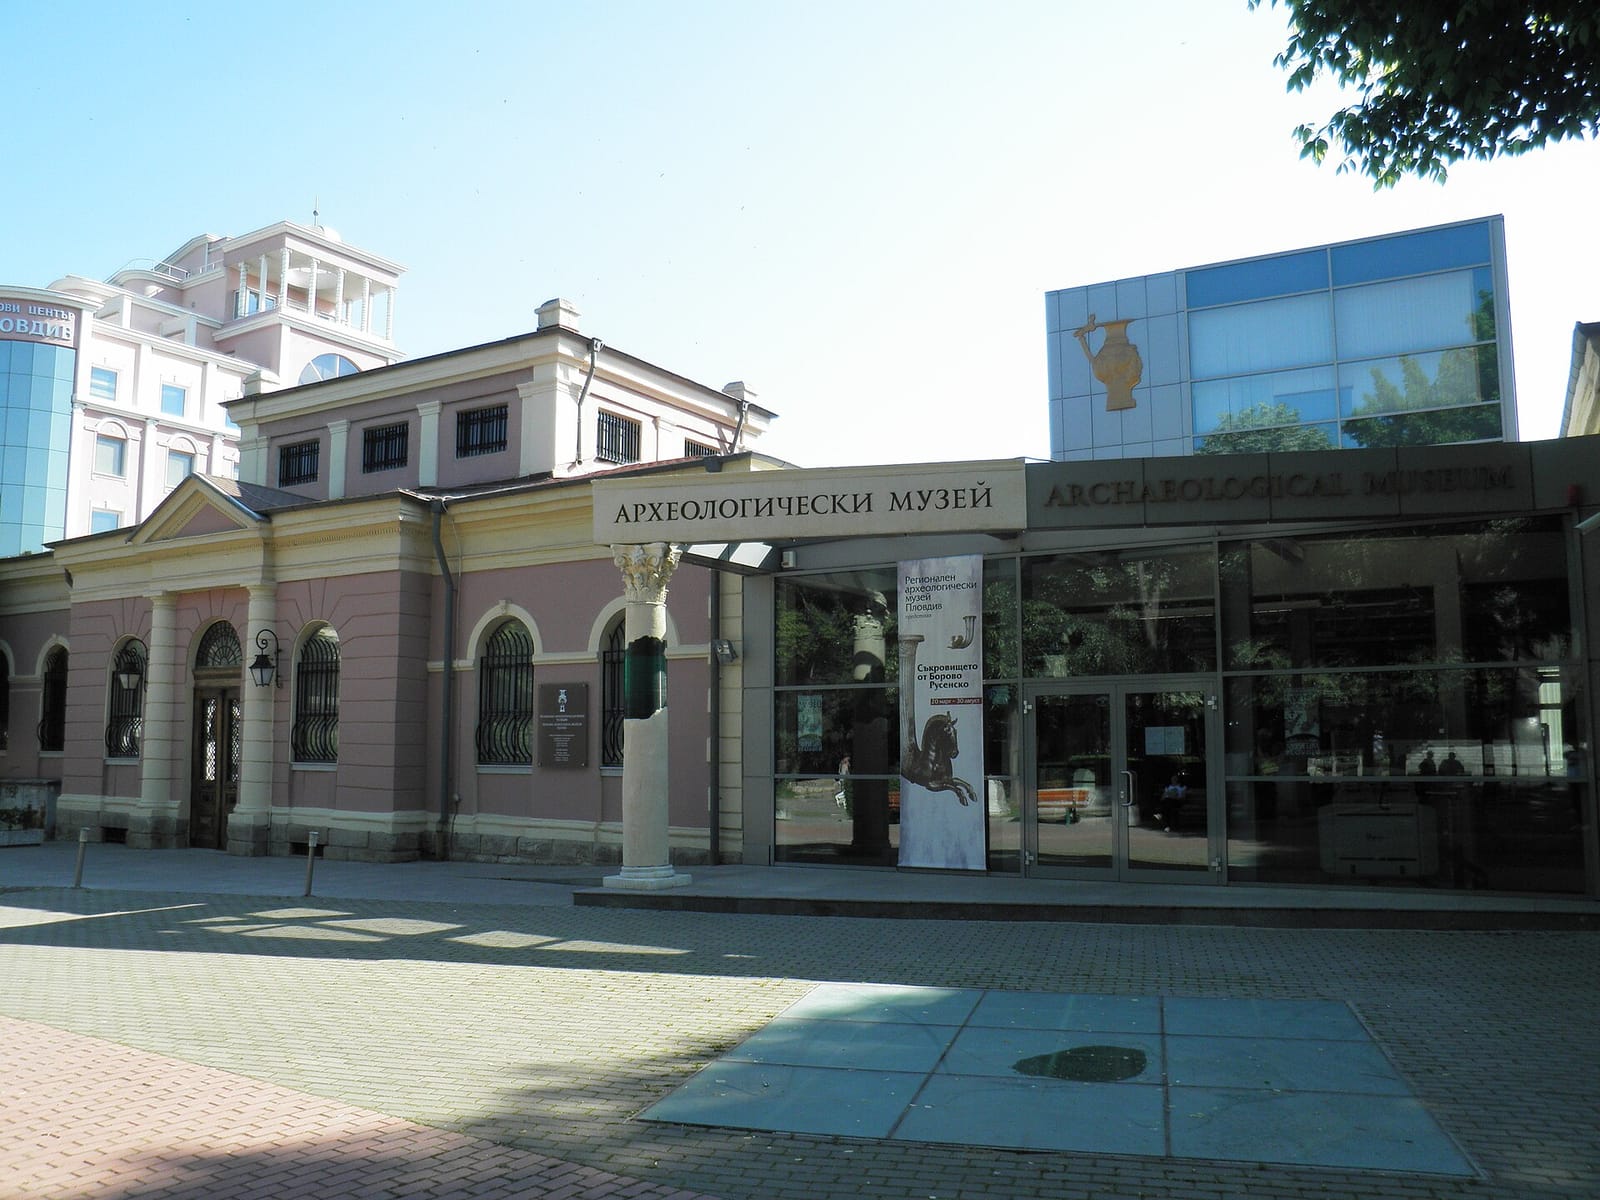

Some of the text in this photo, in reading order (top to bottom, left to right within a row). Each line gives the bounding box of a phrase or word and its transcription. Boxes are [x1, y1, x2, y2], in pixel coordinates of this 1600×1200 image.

[28, 305, 75, 321] ЦЕНТЪР
[0, 317, 72, 339] ОВДИВ
[1044, 465, 1516, 508] ARCHAEOLOGICAL MUSEUM
[614, 481, 993, 524] АРХЕОЛОГИЧЕСКИ МУЗЕЙ
[905, 575, 956, 585] Регионален
[904, 582, 977, 595] археологически
[905, 593, 931, 604] музей
[905, 603, 943, 612] Пловдив
[917, 663, 978, 673] Съкровището
[929, 673, 962, 682] Борово
[929, 681, 969, 691] Русенско
